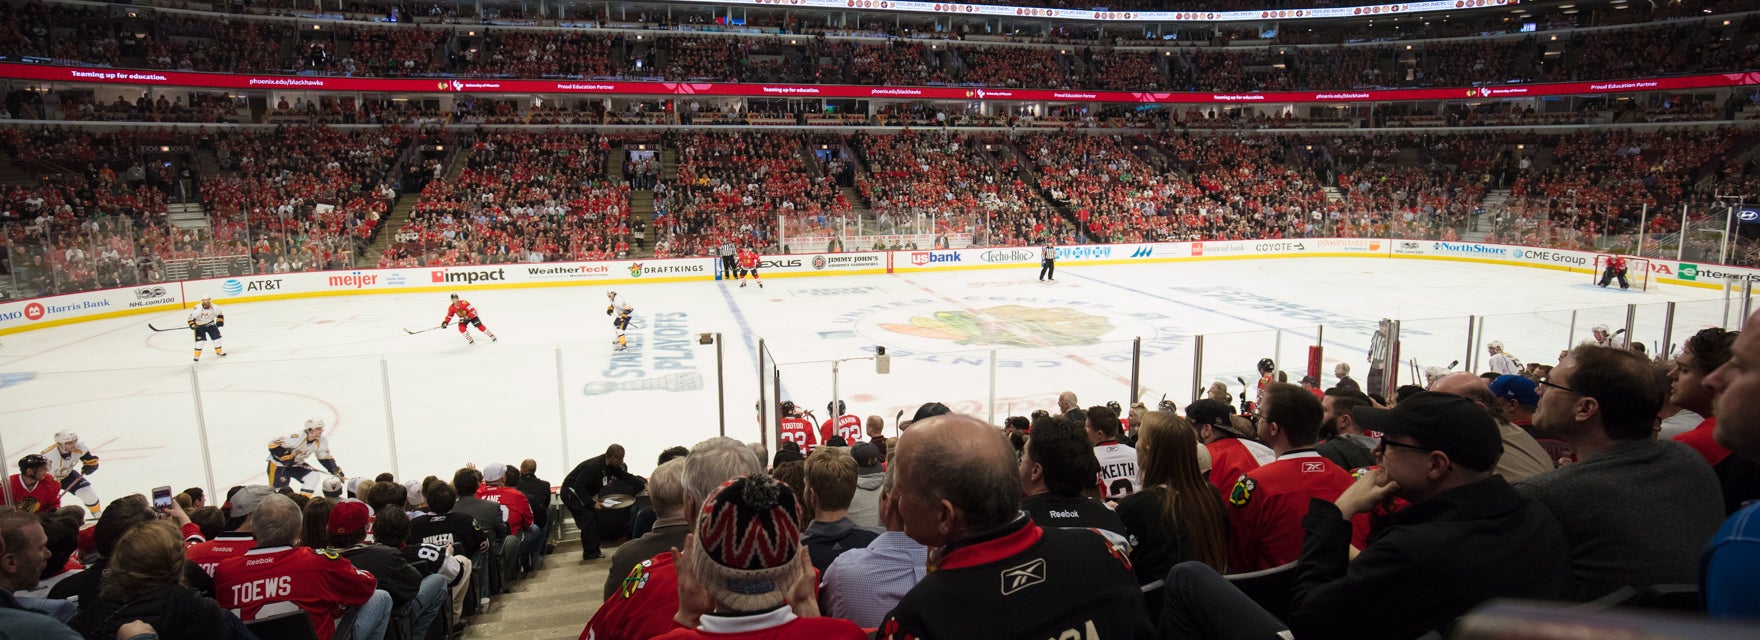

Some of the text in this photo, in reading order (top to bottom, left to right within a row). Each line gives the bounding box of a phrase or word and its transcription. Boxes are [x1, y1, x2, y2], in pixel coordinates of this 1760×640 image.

[71, 70, 105, 79] Teaming
[129, 73, 167, 81] education.
[249, 77, 324, 87] phoenix.edu/blackhawks
[763, 86, 783, 94] Teaming
[1255, 242, 1292, 252] COYOTE
[1441, 242, 1507, 255] NorthShore
[854, 255, 879, 263] JOHN'S
[929, 251, 961, 263] bank
[984, 250, 1032, 263] Techo-Bloc
[1524, 250, 1587, 266] CME Group
[644, 264, 704, 274] DRAFTKINGS
[757, 259, 802, 268] EXUS
[527, 265, 609, 275] WeatherTech
[328, 271, 378, 289] meijer
[444, 268, 505, 285] impact
[247, 279, 283, 292] AT&T
[47, 303, 81, 314] Harris
[83, 298, 110, 309] Bank
[129, 297, 175, 308] NHL.com/100
[652, 311, 698, 371] PLAYOFFS
[782, 422, 804, 430] TOOTOO
[1102, 462, 1135, 479] KEITH
[1049, 509, 1079, 519] Reebok
[246, 557, 275, 567] Reebok
[231, 575, 293, 606] TOEWS
